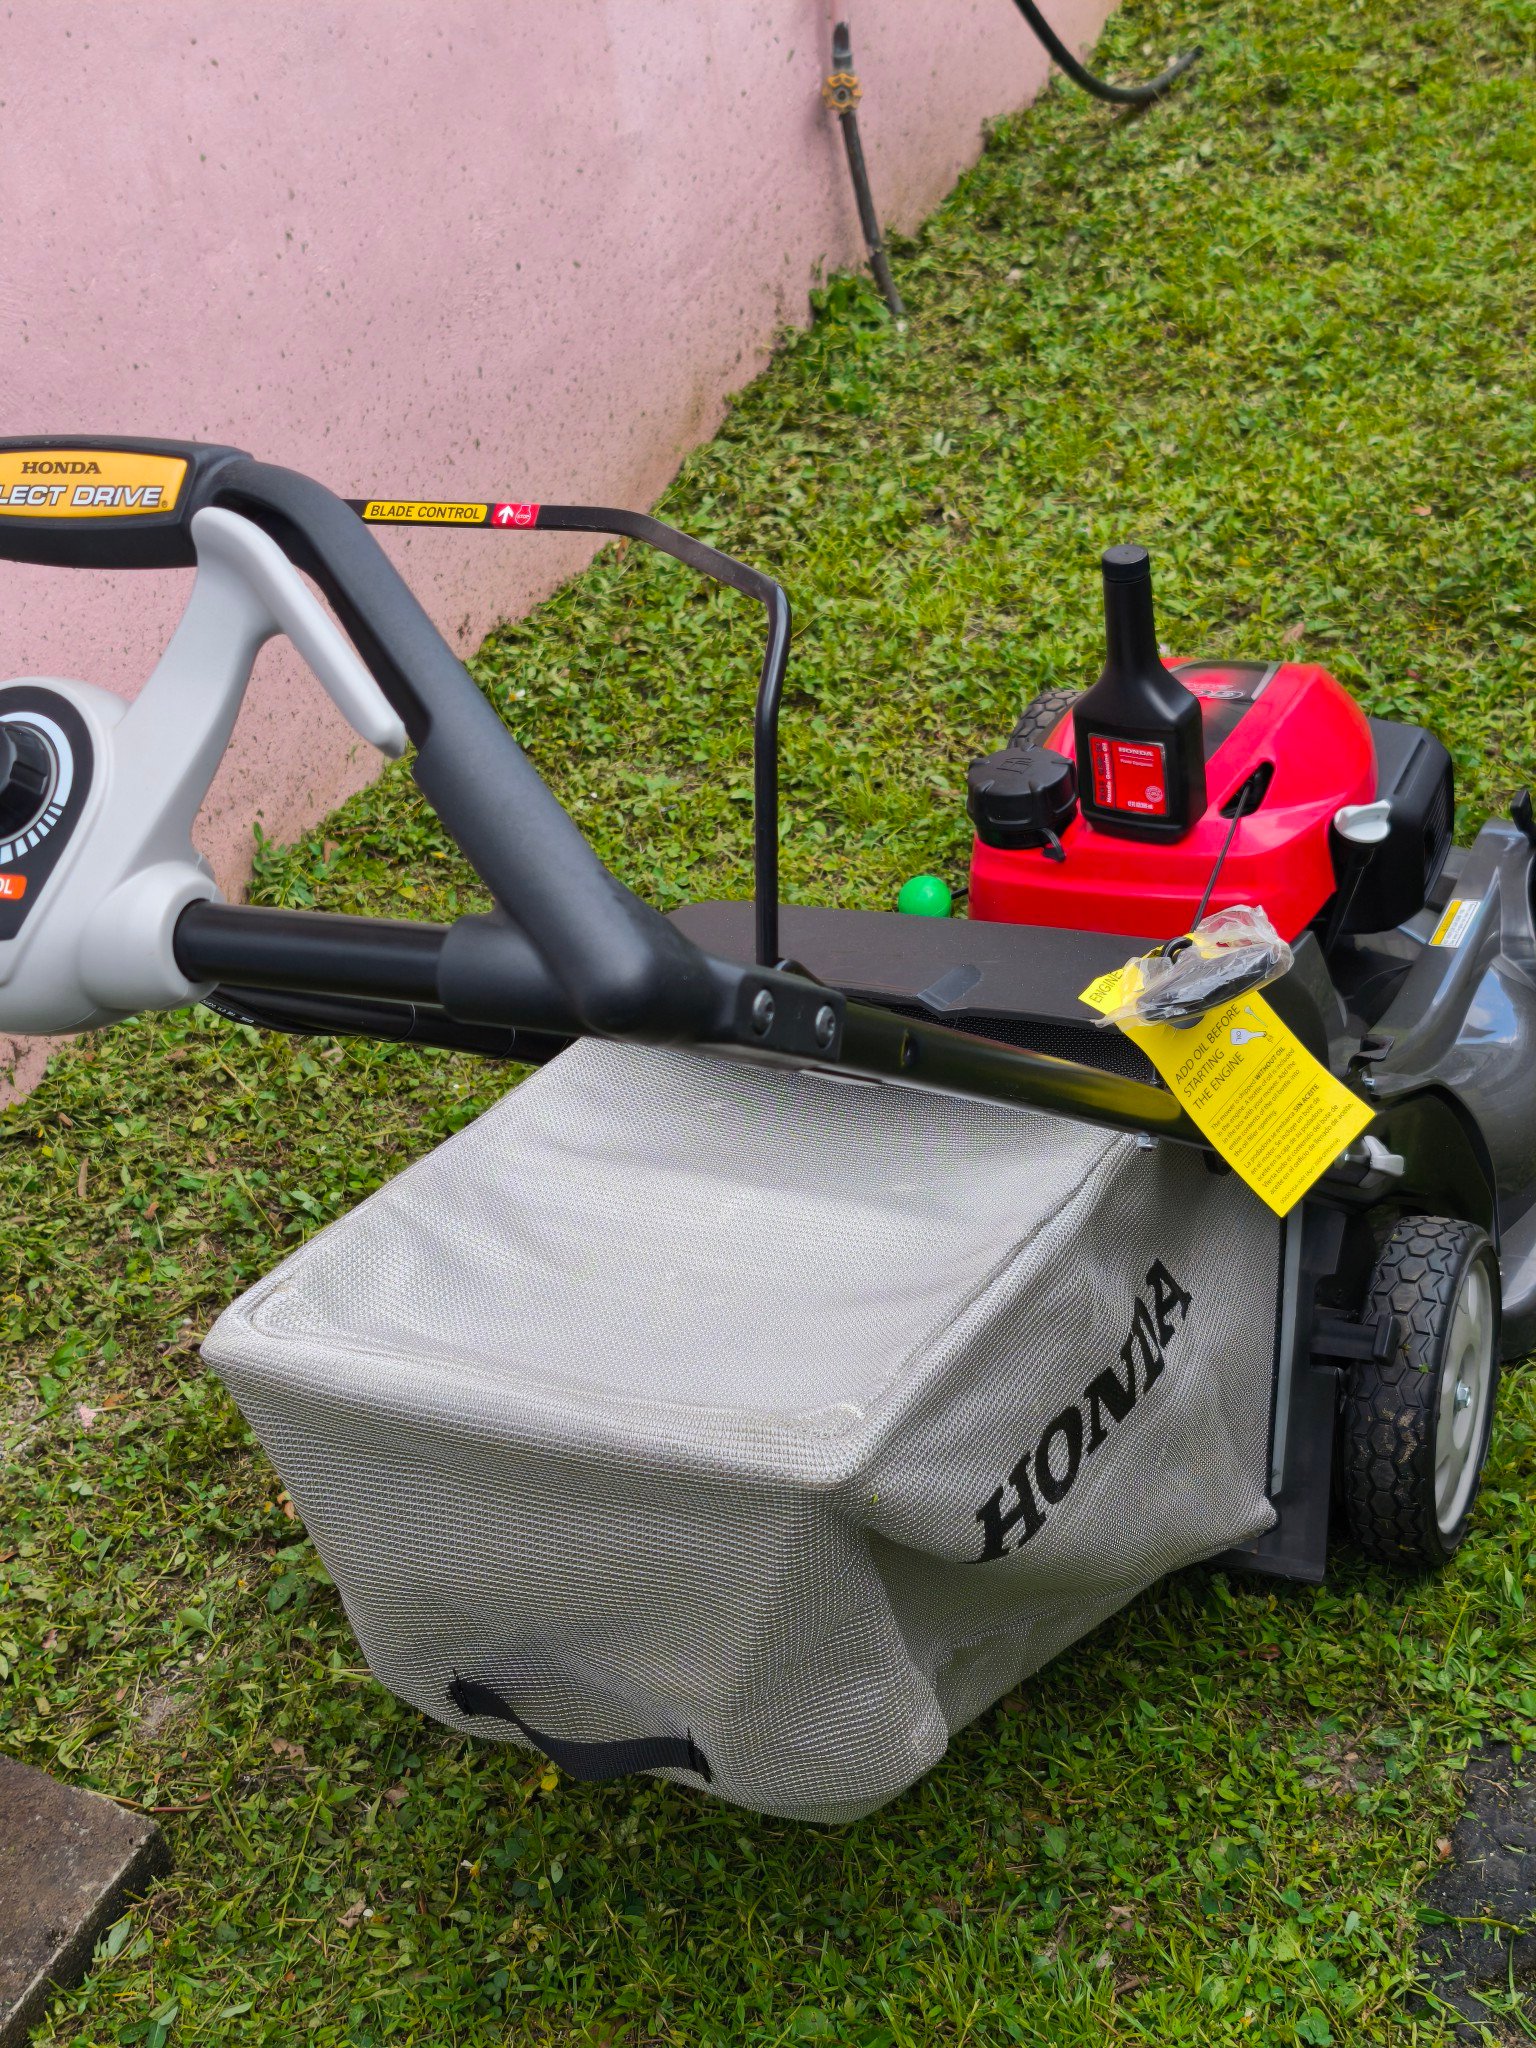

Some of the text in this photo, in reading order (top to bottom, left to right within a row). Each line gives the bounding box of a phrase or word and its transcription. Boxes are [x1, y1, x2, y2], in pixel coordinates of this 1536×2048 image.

[21, 461, 102, 475] HONDA
[370, 505, 480, 519] BLADE CONTROL
[1118, 746, 1154, 756] HONDA
[1088, 970, 1123, 1004] ENGINE
[1174, 1003, 1241, 1084] ADD OIL BEFORE
[1183, 1048, 1225, 1098] STARTING
[1192, 1051, 1245, 1110] THE ENGINE
[1211, 1119, 1221, 1130] The
[1219, 1102, 1236, 1121] mower
[1238, 1078, 1256, 1100] shipped
[1254, 1054, 1277, 1080] WITHOUT
[1275, 1046, 1285, 1056] OIL
[1221, 1122, 1230, 1131] the
[1247, 1085, 1262, 1101] bottle
[1261, 1079, 1267, 1087] of
[1274, 1047, 1295, 1070] included
[1227, 1128, 1236, 1138] the
[1233, 1119, 1244, 1130] box
[1243, 1108, 1254, 1120] with
[1253, 1096, 1263, 1110] your
[1277, 1068, 1288, 1081] Add
[1286, 1060, 1296, 1070] the
[1228, 1069, 1300, 1150] entire contents of the oil bottle into
[1243, 1083, 1319, 1169] La podadora se embarca SIN ACEITE
[1233, 1147, 1243, 1157] the
[1241, 1140, 1249, 1148] oil
[1246, 1129, 1258, 1142] filler
[1250, 1167, 1258, 1175] en
[1274, 1139, 1282, 1147] Se
[1280, 1122, 1298, 1140] incluye
[1296, 1115, 1304, 1123] un
[1301, 1103, 1314, 1117] bote
[1312, 1096, 1320, 1105] de
[1256, 1165, 1271, 1181] aceite
[1269, 1159, 1277, 1167] en
[1280, 1144, 1291, 1155] caja
[1289, 1137, 1297, 1145] de
[1295, 1130, 1302, 1138] su
[1262, 1104, 1338, 1188] Vierta todo el contenido del bote de
[1269, 1178, 1284, 1195] aceite
[1282, 1172, 1290, 1180] en
[1288, 1165, 1295, 1173] el
[1293, 1150, 1309, 1168] orificio
[1308, 1143, 1316, 1151] de
[1313, 1125, 1332, 1144] llenado
[1330, 1118, 1338, 1126] de
[958, 1258, 1193, 1565] HONDA
